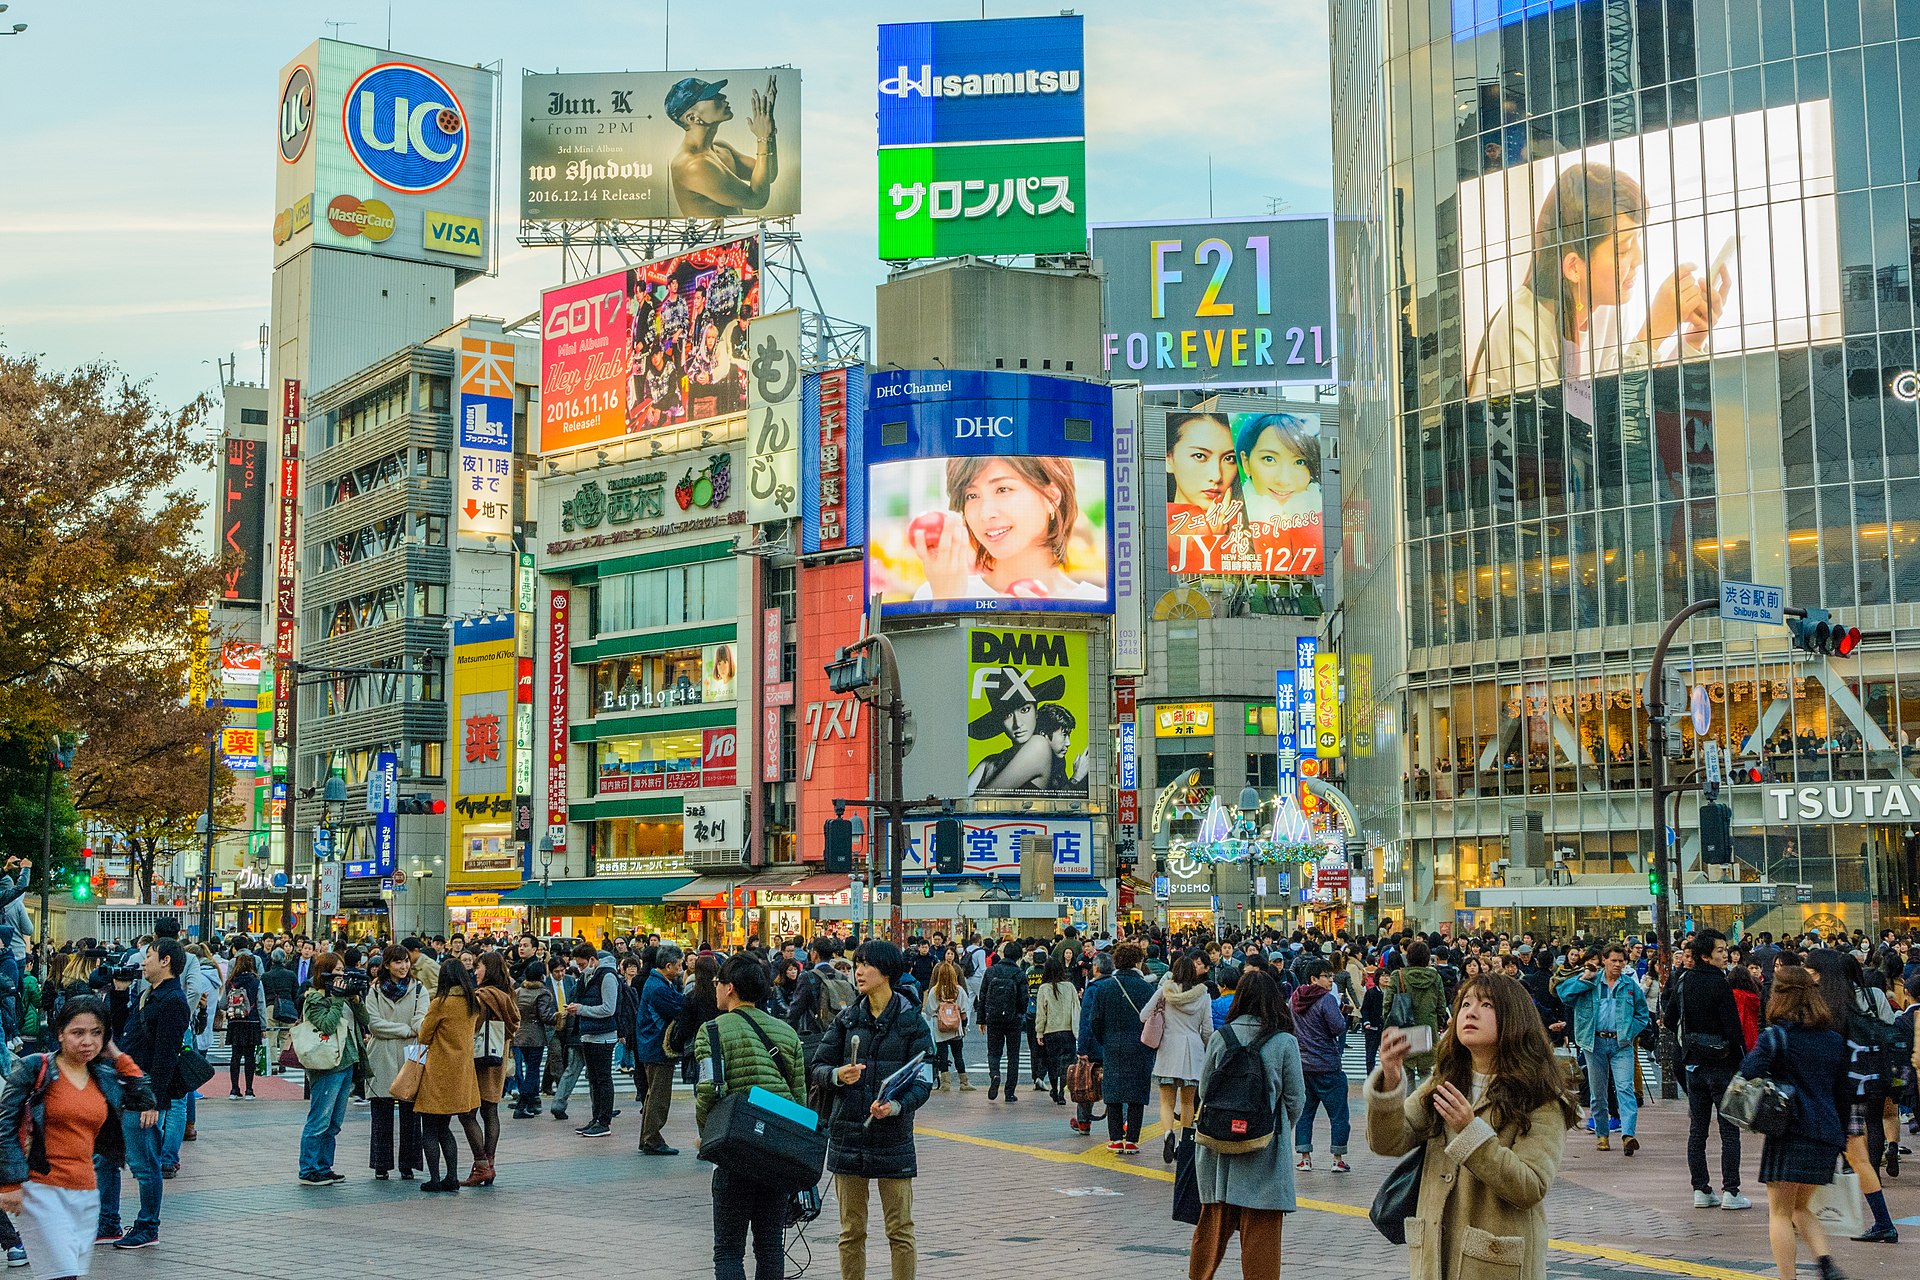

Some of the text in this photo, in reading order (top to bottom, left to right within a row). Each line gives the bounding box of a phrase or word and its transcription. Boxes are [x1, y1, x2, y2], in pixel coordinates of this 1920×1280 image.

[547, 90, 633, 116] Jun. K
[360, 90, 462, 163] UC
[548, 122, 633, 135] from 2PM
[558, 144, 623, 154] 3rd Mini Album
[528, 159, 653, 186] no shadow
[528, 188, 651, 203] 2016.12.14 Release!
[888, 176, 1075, 220] サロンパス
[328, 207, 394, 229] MasterCard
[432, 222, 480, 246] VISA
[1150, 235, 1271, 320] F21
[544, 289, 623, 341] GOT7
[557, 335, 609, 358] Mini Album
[1103, 326, 1323, 371] FOREVER 21
[461, 340, 514, 397] 本
[544, 358, 582, 396] Hey
[876, 380, 952, 398] DHC Channel
[466, 405, 475, 432] BOOK
[547, 389, 618, 423] 2016.11.16
[563, 416, 601, 433] Release!!
[752, 334, 797, 513] もんじゃ
[955, 416, 1013, 438] DHC
[465, 434, 508, 445] ブックファースト
[245, 440, 255, 488] TOKYO
[462, 455, 509, 476] 夜11時
[819, 375, 841, 539] 三千里薬品
[1116, 420, 1134, 511] Taisei
[471, 475, 500, 493] まで
[482, 501, 508, 520] 地下
[606, 484, 665, 525] 西村
[1170, 499, 1244, 535] フェイク
[1117, 521, 1132, 597] neon
[1171, 535, 1225, 572] JY
[1221, 561, 1262, 571] 同時発売
[1265, 548, 1317, 572] 12/7
[976, 600, 997, 609] DHC
[1725, 586, 1779, 609] 渋谷駅前
[1733, 606, 1772, 619] Shibuya Sta.
[767, 613, 778, 679] お好み焼
[1118, 639, 1138, 648] 3719
[1119, 630, 1136, 639] (03)
[457, 650, 495, 664] Matsumoto
[971, 631, 1069, 667] DMM
[1118, 647, 1138, 655] 2468
[519, 676, 531, 685] JTB
[552, 622, 565, 751] ウィンターフルーツギフト
[971, 666, 1037, 702] FX
[1692, 676, 1807, 704] OFFEE
[603, 683, 697, 711] Euphoria
[1298, 643, 1316, 749] 洋服の青山
[1318, 663, 1333, 728] くいしんぼ
[1174, 710, 1195, 722] 麻雀
[228, 730, 254, 753] 薬
[465, 713, 500, 762] 薬
[705, 734, 736, 762] JTB
[767, 710, 777, 777] もんじゃ焼
[1278, 684, 1296, 799] 洋服の青山
[1320, 735, 1335, 745] 4F
[1123, 727, 1134, 786] 大盛堂商事ビル
[601, 780, 628, 791] 国内旅行
[633, 778, 662, 788] 海外旅行
[1120, 795, 1134, 822] 焼肉
[903, 829, 1083, 865] 大堂店
[1121, 825, 1135, 852] 牛繁
[324, 867, 332, 909] 道玄坂
[819, 890, 869, 905] 三千里
